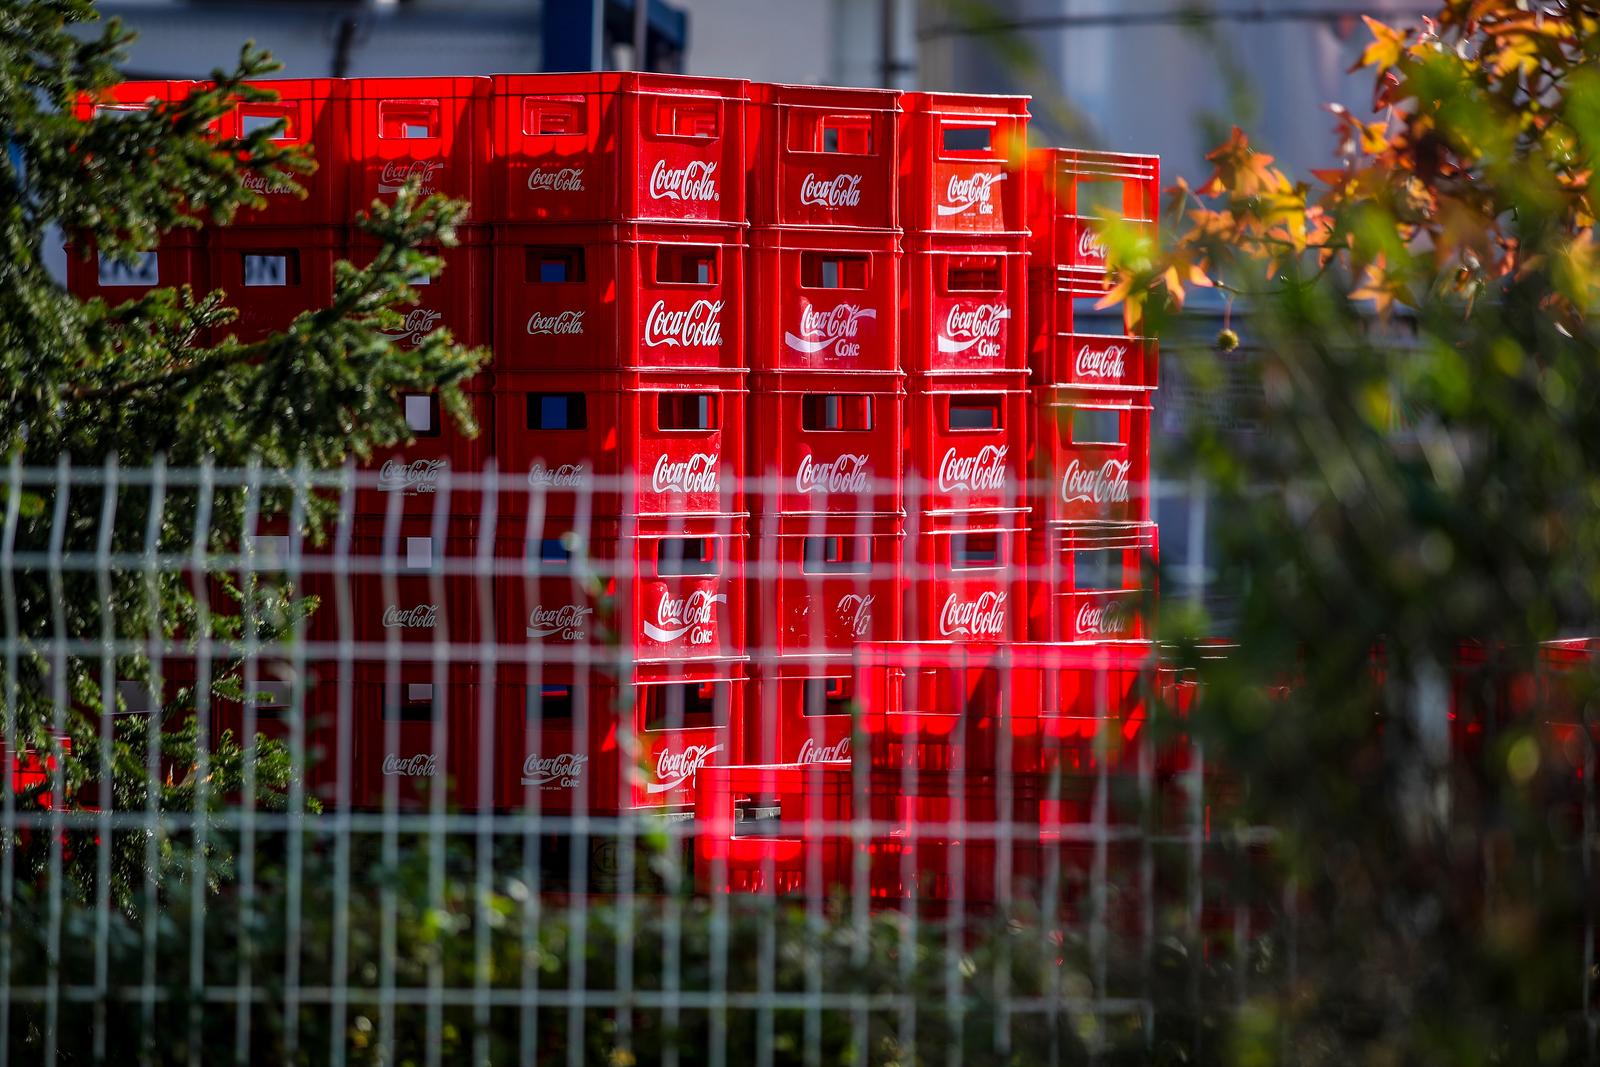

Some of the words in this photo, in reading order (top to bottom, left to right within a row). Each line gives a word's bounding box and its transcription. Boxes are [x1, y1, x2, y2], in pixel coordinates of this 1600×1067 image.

[528, 168, 584, 191] Coca-Cola
[650, 159, 718, 201] Coca-Cola
[801, 173, 862, 206] Coca-Cola
[948, 172, 992, 203] Coca-Cola
[979, 202, 993, 214] Coke
[527, 311, 585, 334] Coca-Cola
[645, 300, 725, 347] Coca-Cola
[801, 304, 860, 337] Coca-Cola
[947, 304, 1003, 337] Coca-Cola
[835, 339, 860, 357] Coke
[977, 339, 1000, 357] Coke
[1076, 344, 1127, 378] Coca-Cola
[653, 453, 719, 493] Coca-Cola
[796, 453, 870, 493] Coca-Cola
[938, 445, 1009, 492] Coca-Cola
[1062, 459, 1132, 502] Coca-Cola
[382, 604, 439, 628] Coca-Cola
[530, 605, 585, 627] Coca-Cola
[940, 591, 1007, 636] Coca-Cola
[562, 628, 584, 640] Coke
[690, 626, 713, 645] Coke
[382, 753, 438, 777] Coca-Cola
[523, 753, 584, 777] Coca-Cola
